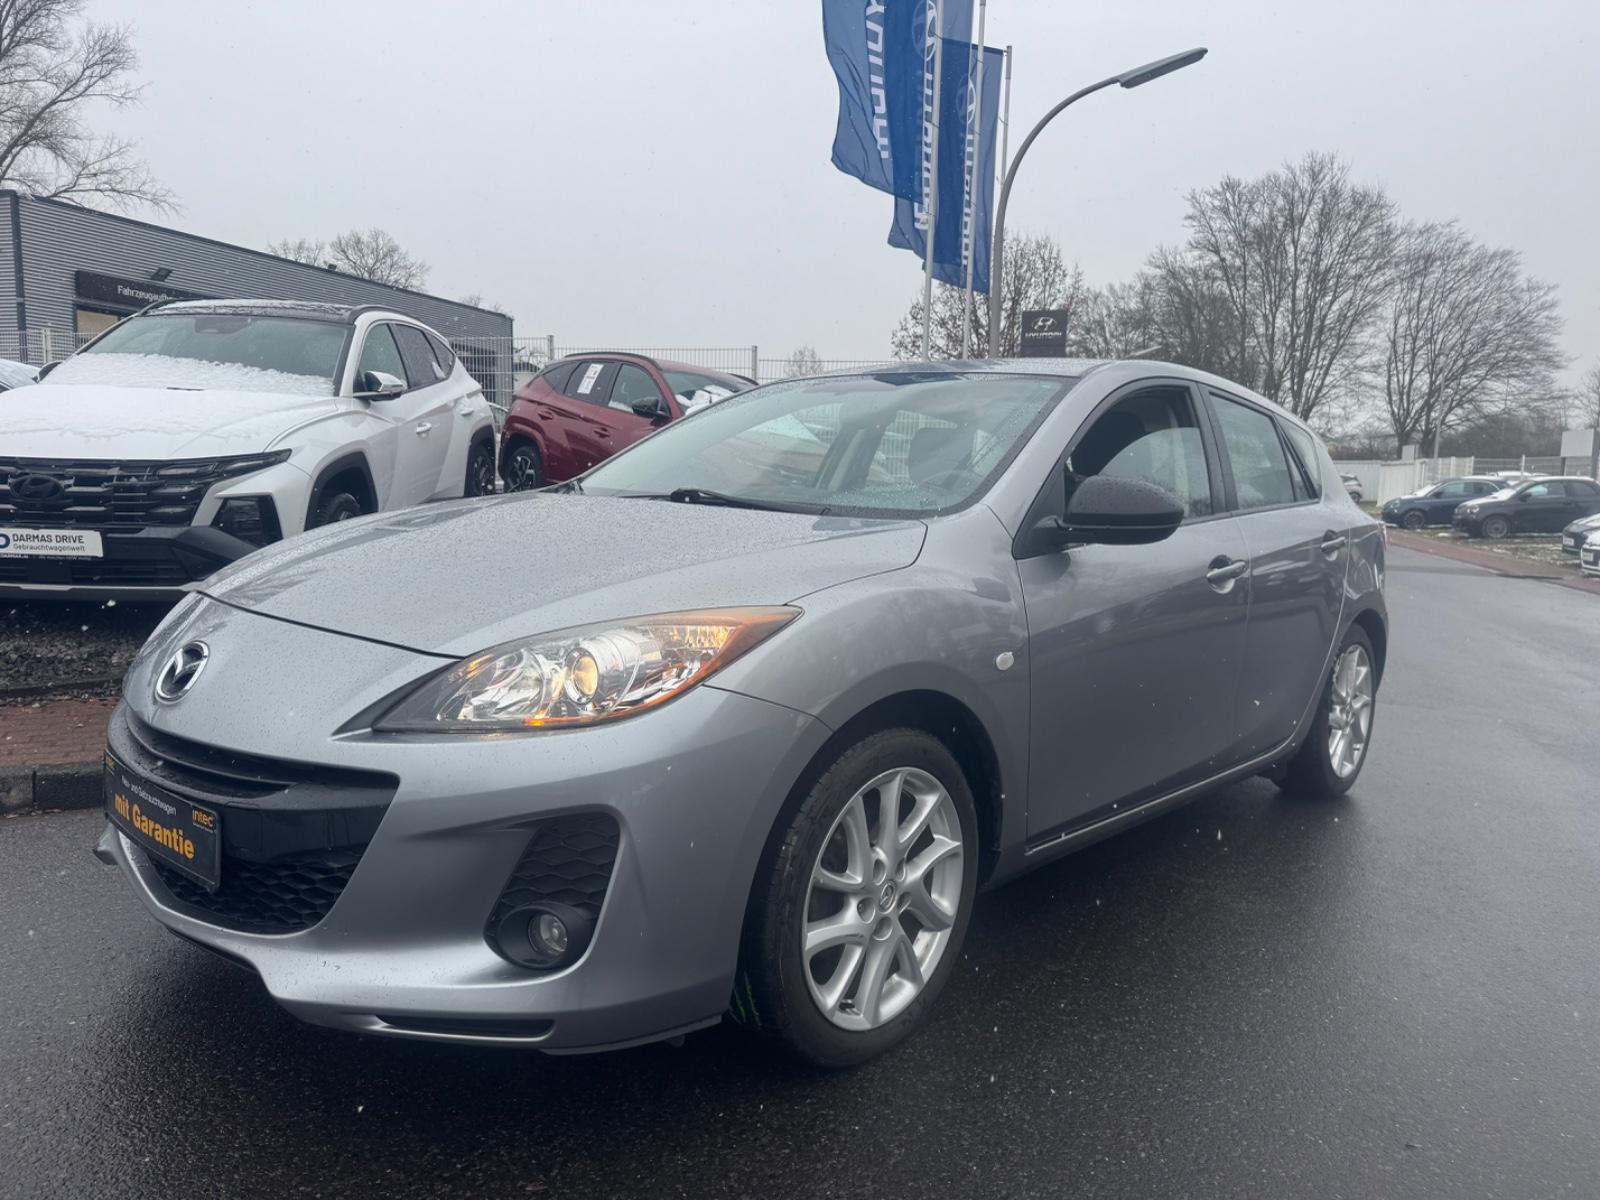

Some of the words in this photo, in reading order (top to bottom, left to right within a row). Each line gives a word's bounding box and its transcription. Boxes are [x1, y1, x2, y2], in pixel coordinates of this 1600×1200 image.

[12, 533, 53, 544] DARMAS
[55, 535, 84, 544] DRIVE
[13, 543, 85, 552] Gebrauchtwagenwelt
[114, 792, 130, 821] mit
[132, 803, 195, 860] Garantie
